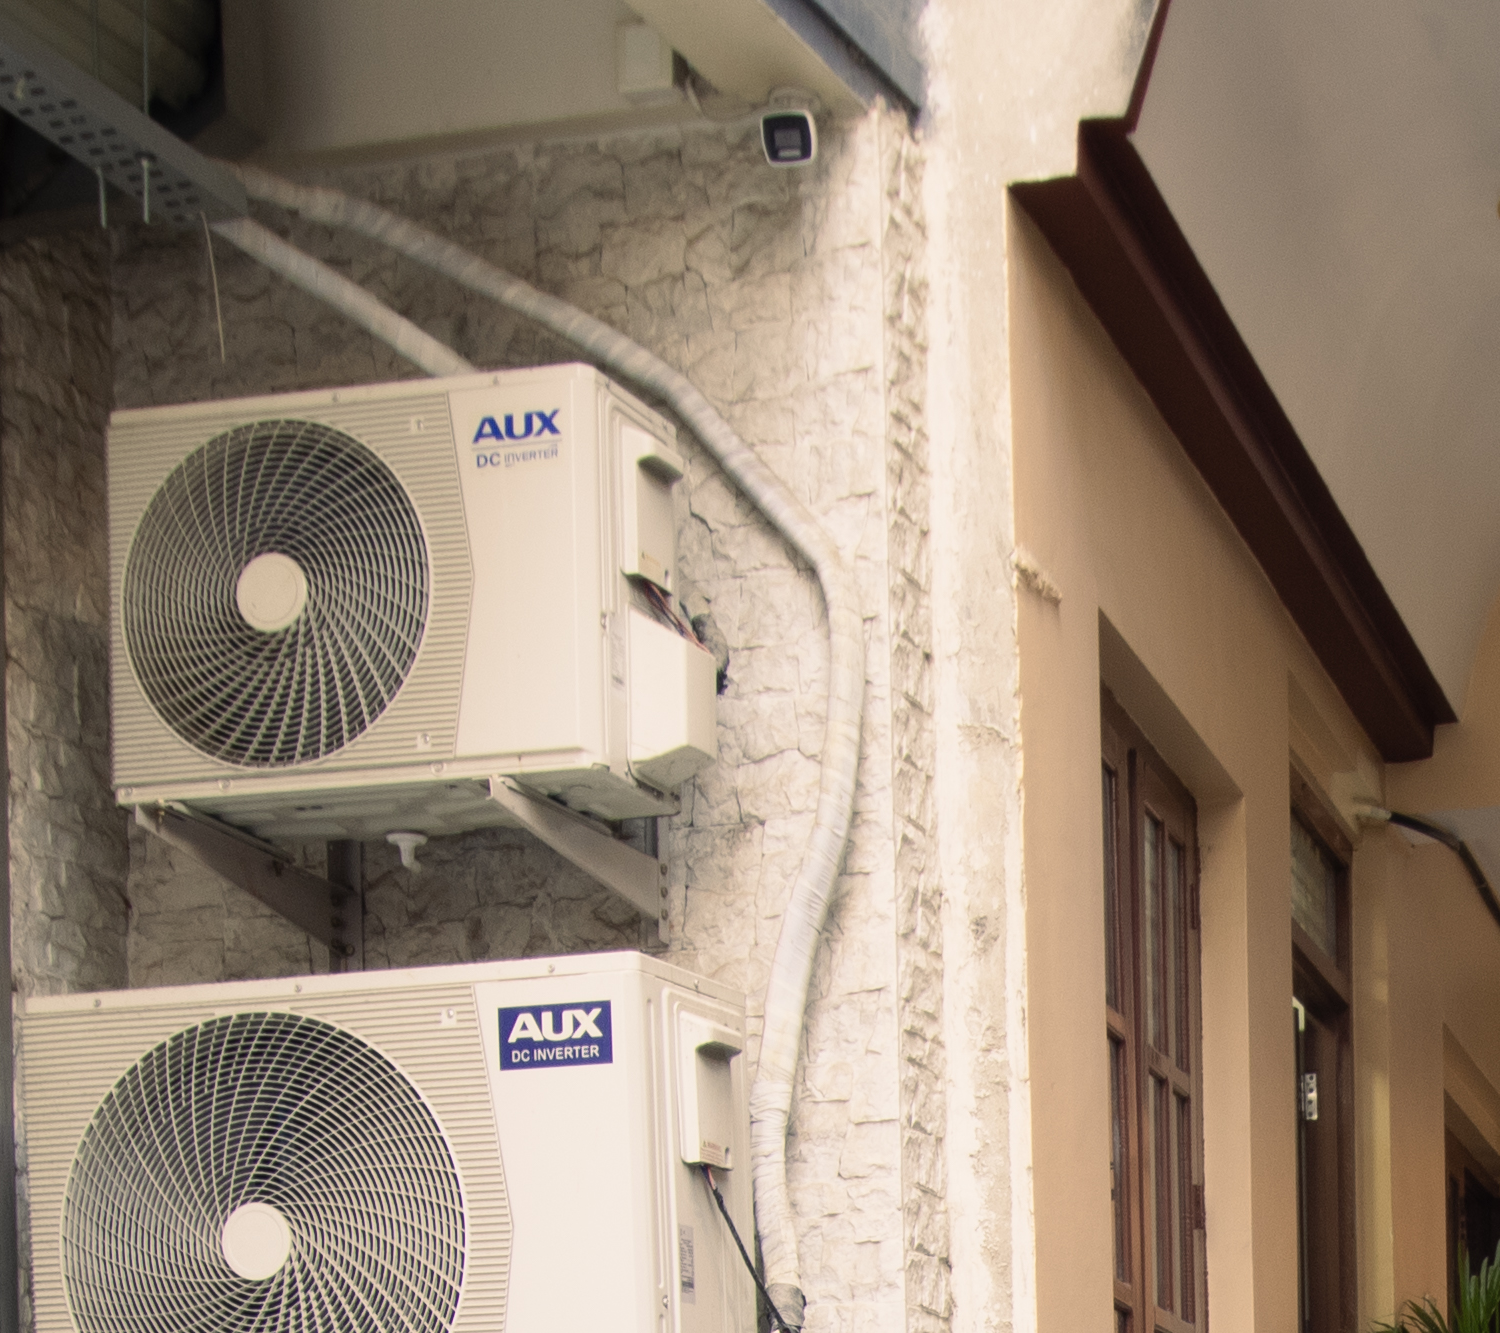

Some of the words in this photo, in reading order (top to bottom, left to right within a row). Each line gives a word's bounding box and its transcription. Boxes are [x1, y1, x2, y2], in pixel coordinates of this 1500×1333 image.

[472, 408, 561, 444] AUX
[476, 453, 500, 468] DC
[507, 1007, 603, 1043] AUX
[511, 1049, 530, 1063] DC
[533, 1044, 600, 1061] INVERTER
